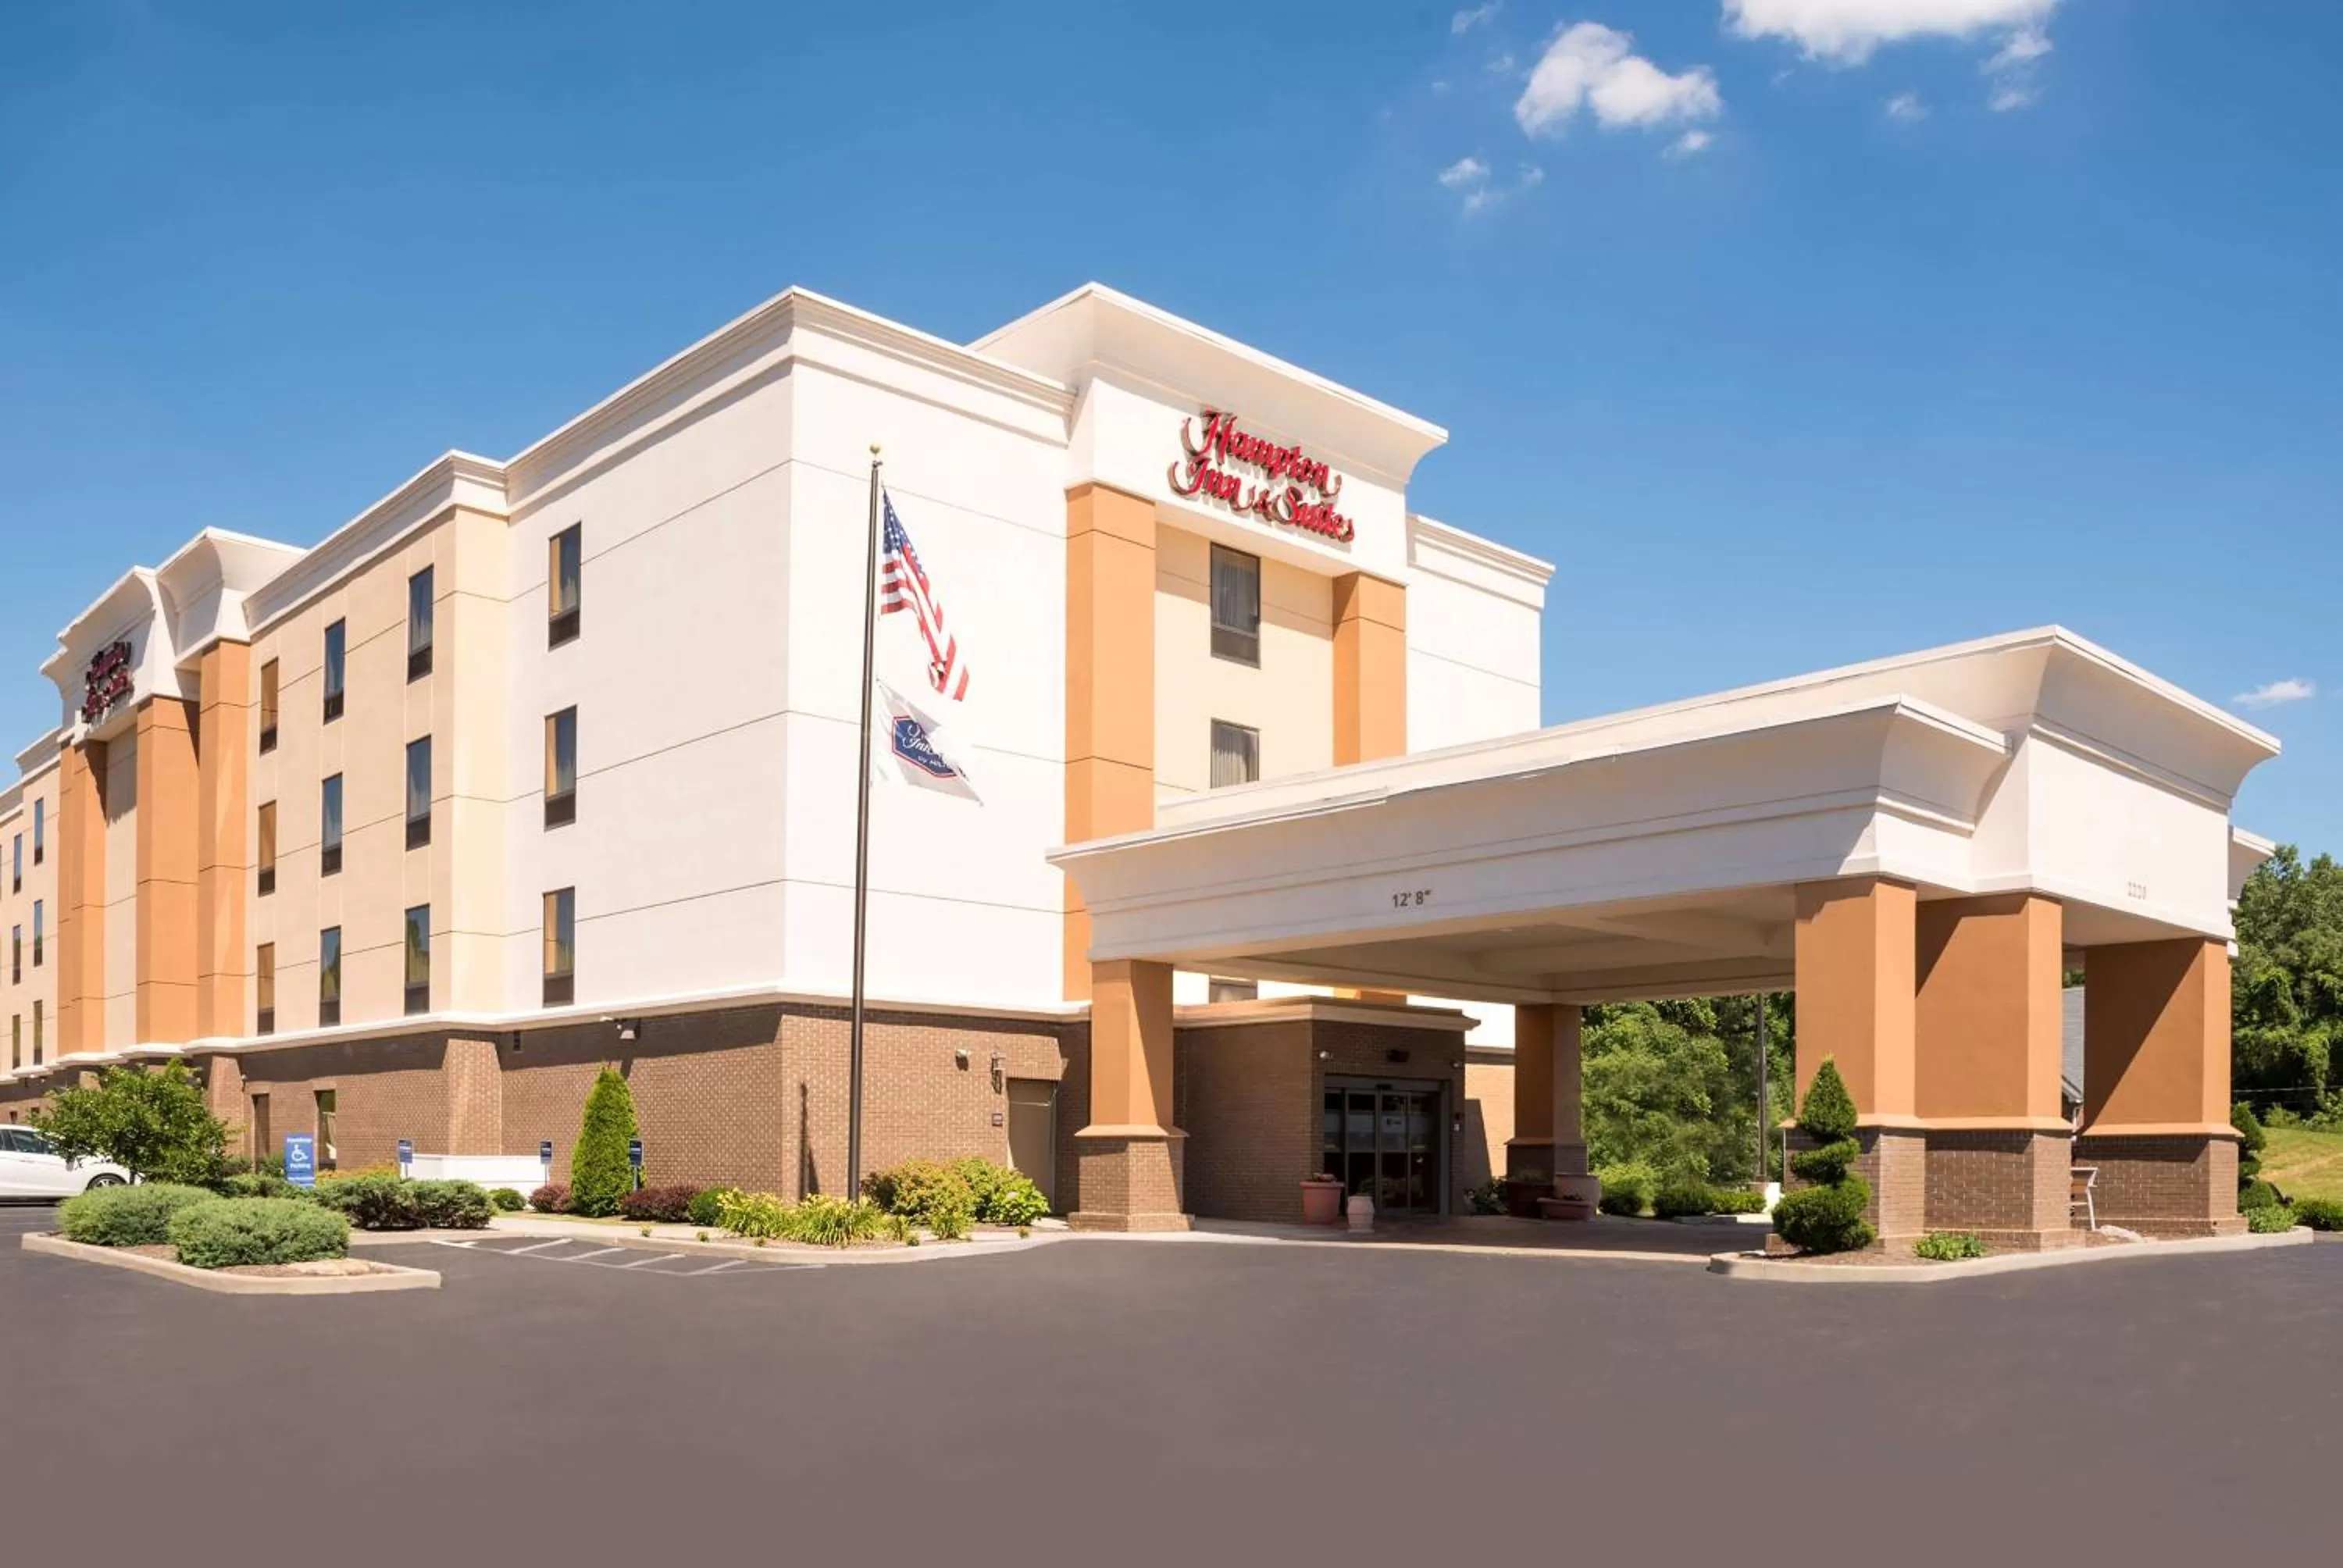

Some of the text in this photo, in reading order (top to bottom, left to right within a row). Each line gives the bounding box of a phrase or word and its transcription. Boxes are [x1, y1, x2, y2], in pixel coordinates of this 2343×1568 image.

[1181, 408, 1342, 497] Hampton
[1168, 458, 1254, 511] Inn
[1271, 486, 1354, 542] Suites
[1393, 889, 1431, 908] 12' 8"
